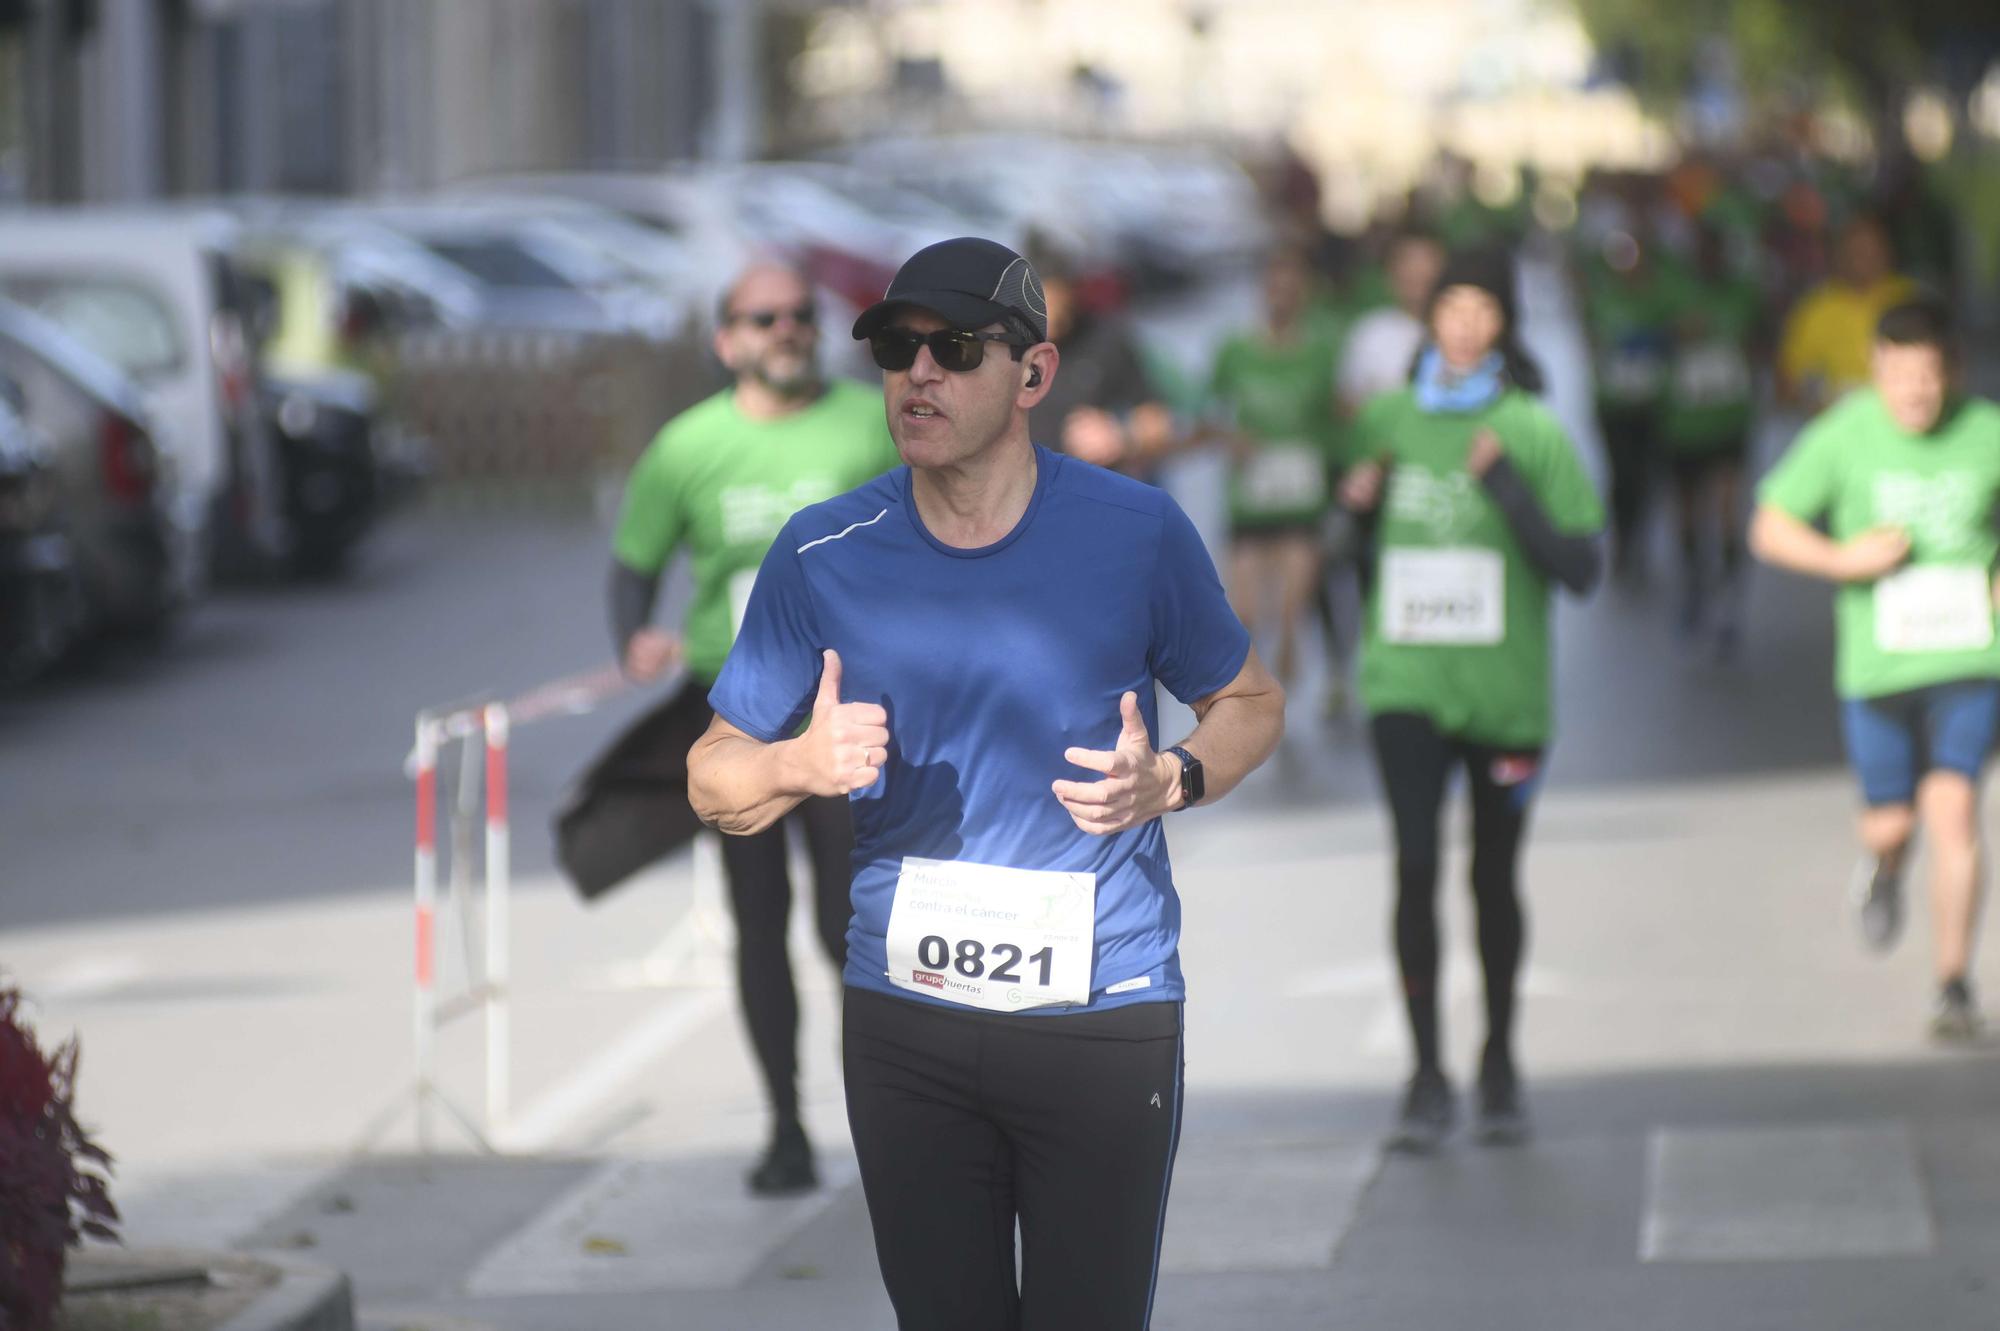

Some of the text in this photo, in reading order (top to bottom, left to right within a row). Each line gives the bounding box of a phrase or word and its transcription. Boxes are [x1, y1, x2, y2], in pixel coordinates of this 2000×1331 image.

[909, 900, 952, 914] contra
[955, 904, 968, 916] el
[918, 935, 1053, 987] 0821
